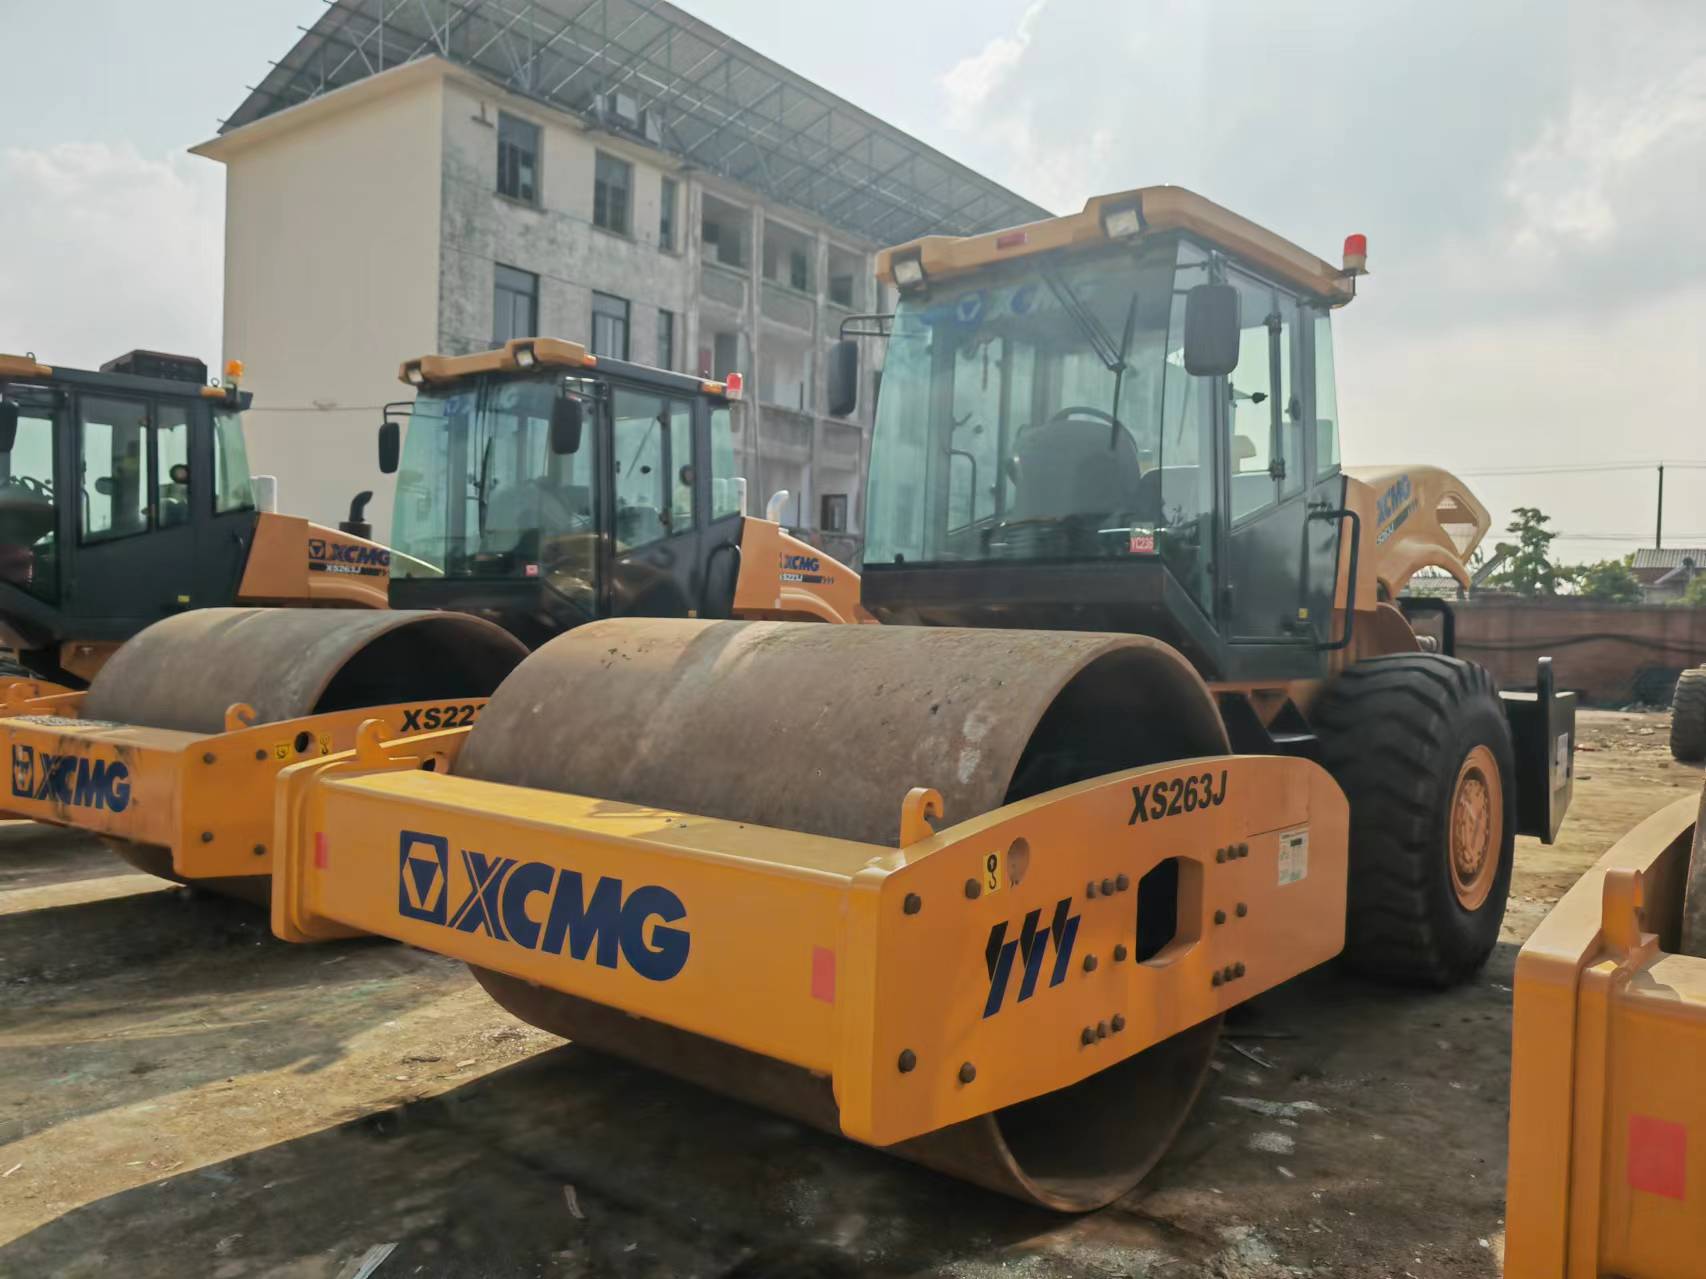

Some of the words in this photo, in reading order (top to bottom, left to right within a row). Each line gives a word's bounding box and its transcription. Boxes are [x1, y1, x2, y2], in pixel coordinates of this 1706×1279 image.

[329, 543, 390, 566] XCMG
[784, 555, 820, 571] XCMG
[34, 751, 131, 812] XCMG
[1128, 770, 1228, 825] XS263J
[448, 849, 691, 981] XCMG
